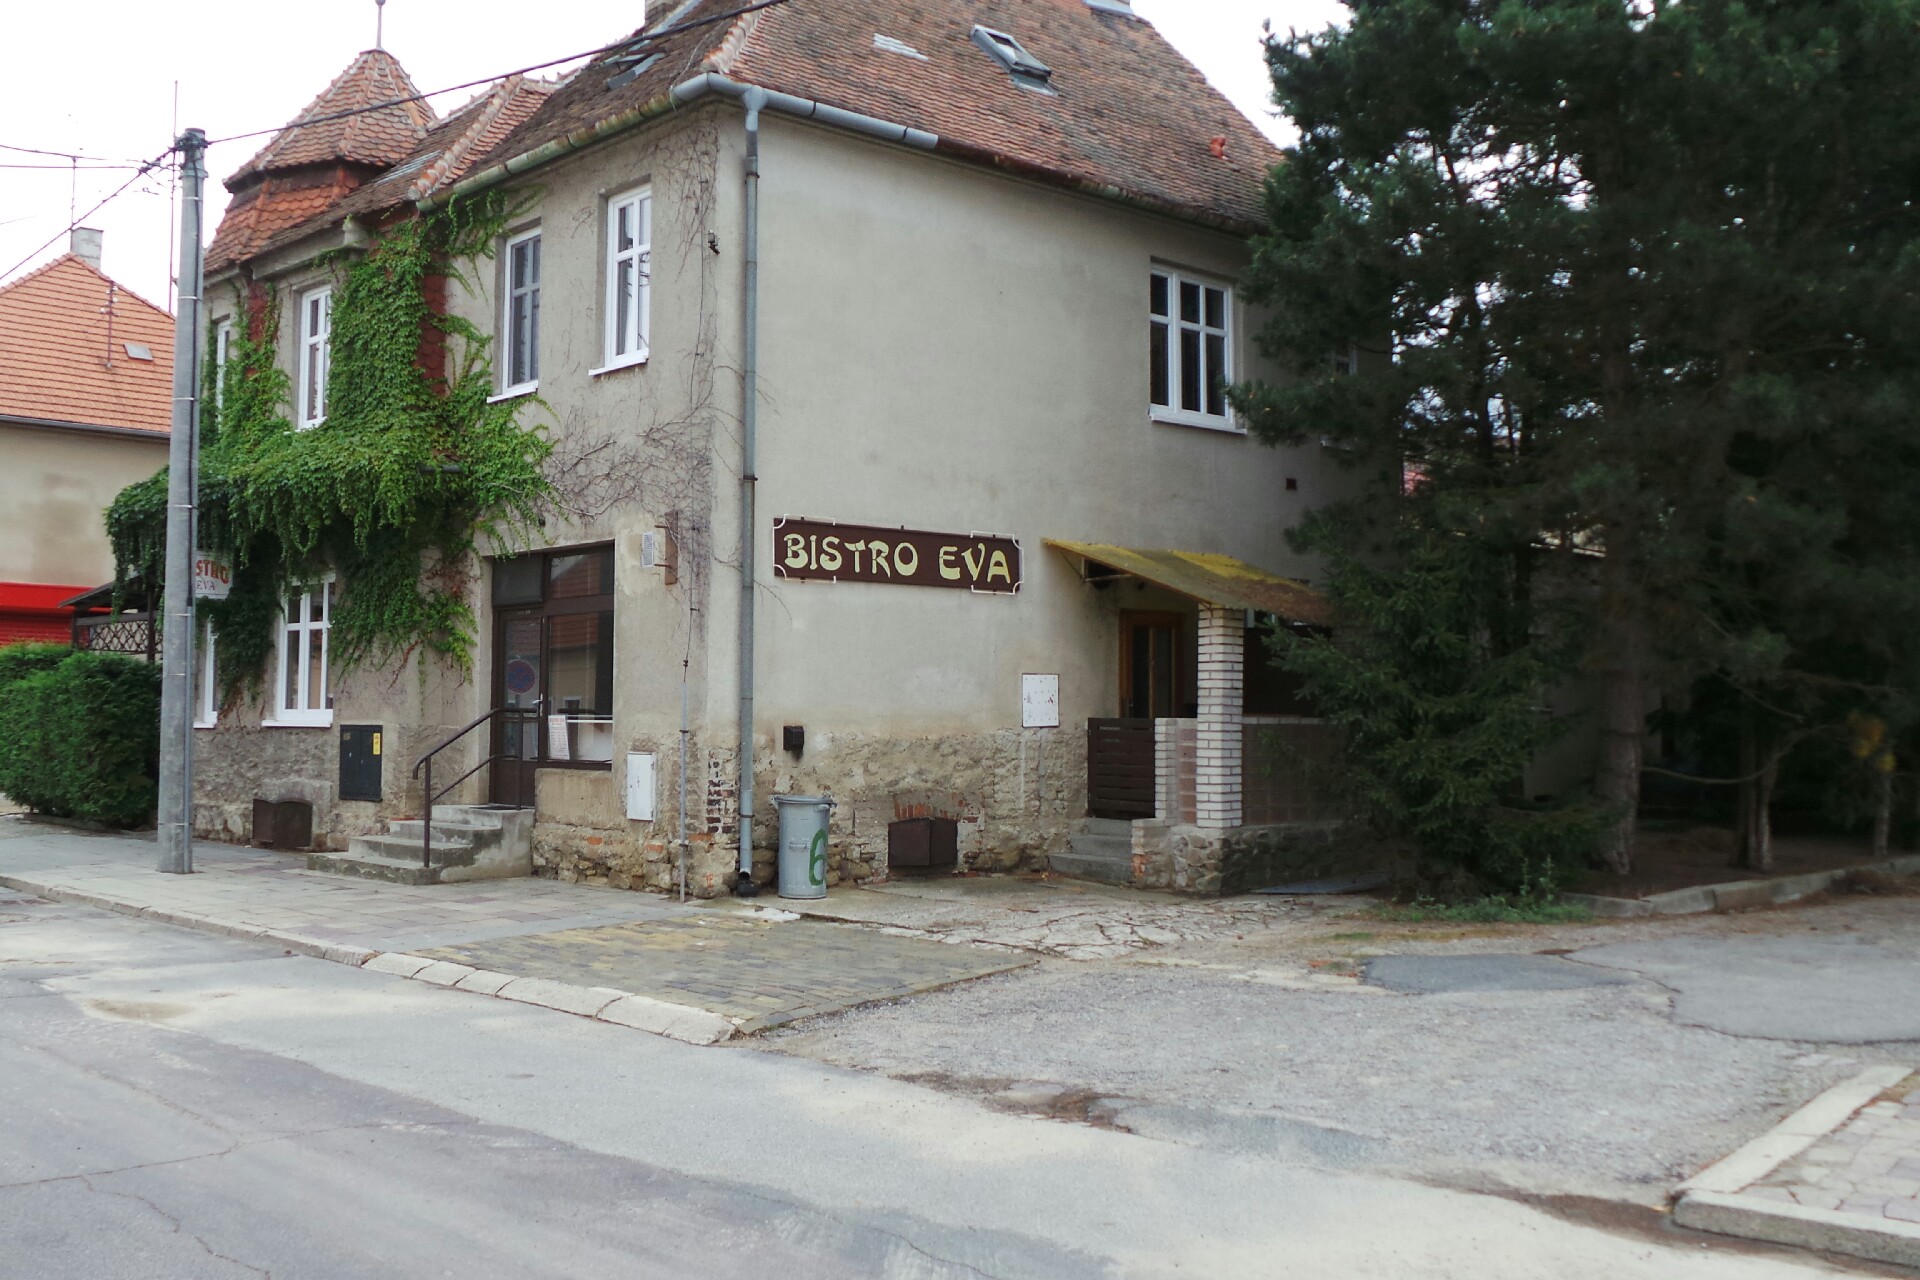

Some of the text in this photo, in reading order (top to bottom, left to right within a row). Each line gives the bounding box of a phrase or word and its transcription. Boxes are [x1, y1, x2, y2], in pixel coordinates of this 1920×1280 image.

[196, 559, 229, 584] STRO
[784, 533, 1010, 584] BISTRO EVA
[809, 828, 828, 886] 6
